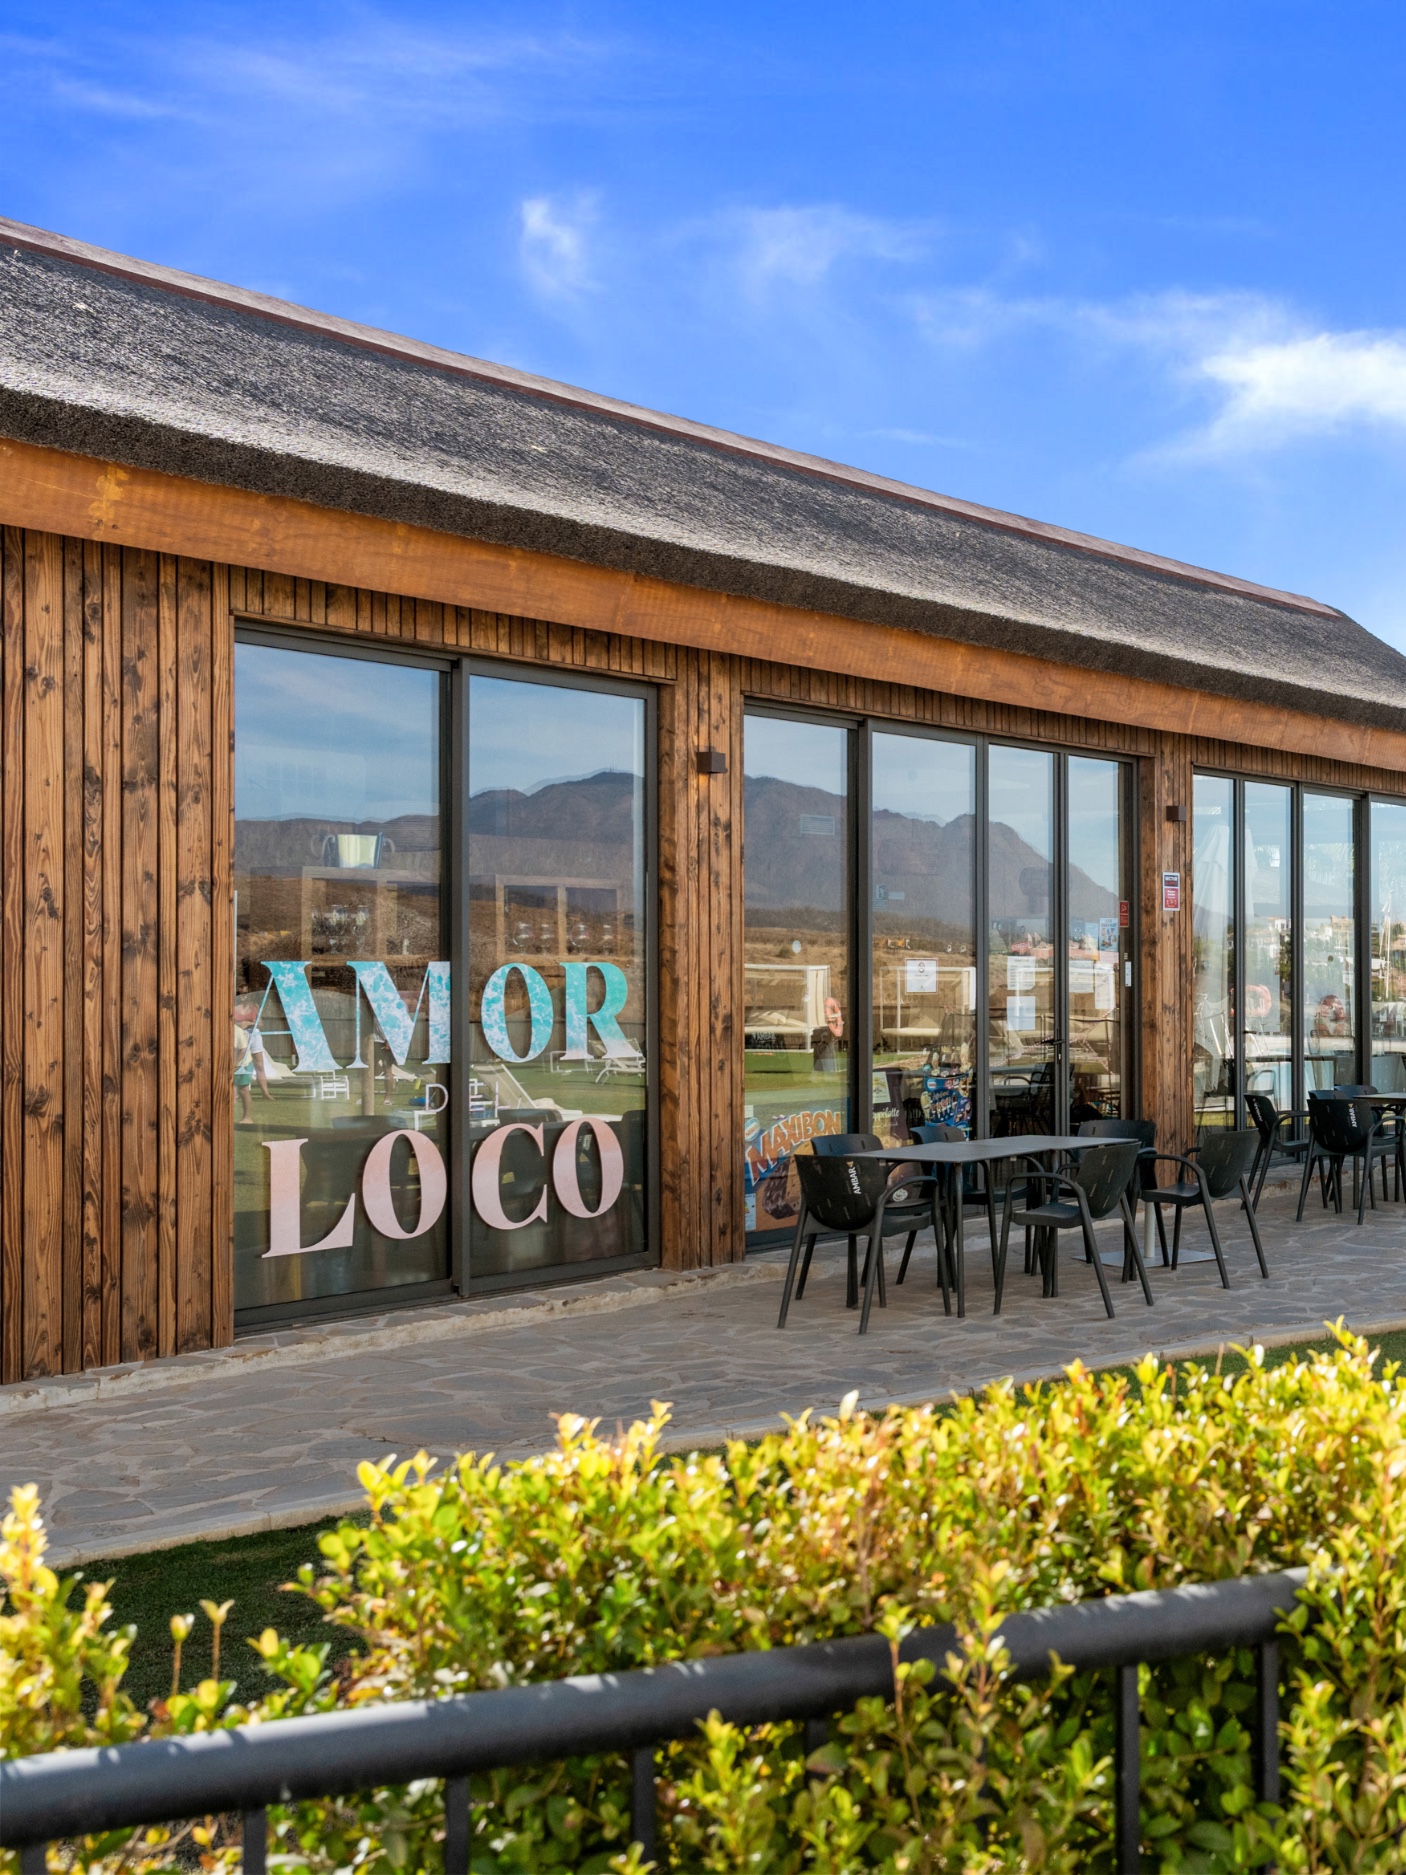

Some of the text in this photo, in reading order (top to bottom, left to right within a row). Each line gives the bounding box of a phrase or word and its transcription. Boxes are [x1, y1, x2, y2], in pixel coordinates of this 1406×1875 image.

[234, 960, 645, 1075] AMOR
[425, 1081, 511, 1113] DEL
[1349, 1108, 1358, 1128] AMBAR
[746, 1109, 842, 1187] MAXIBON
[261, 1117, 625, 1259] LOCO
[848, 1166, 862, 1195] AMBAR
